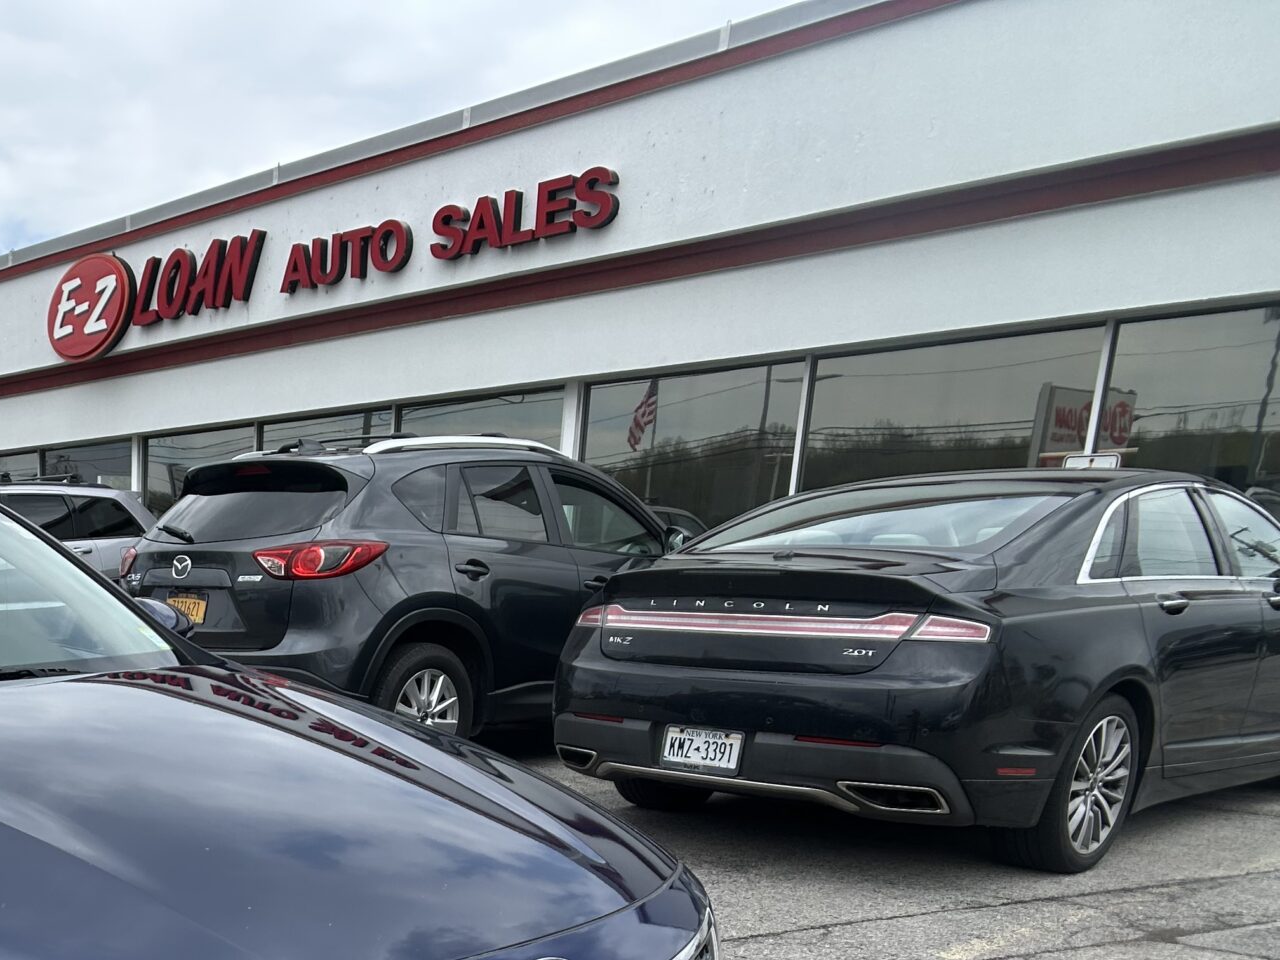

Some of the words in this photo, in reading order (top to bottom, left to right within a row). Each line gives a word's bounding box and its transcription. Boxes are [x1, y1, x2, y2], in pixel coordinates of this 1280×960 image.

[53, 274, 117, 340] E-Z
[132, 229, 267, 326] LOAN
[280, 219, 413, 293] AUTO
[430, 166, 619, 261] SALES
[650, 600, 830, 611] LINCOLN
[685, 729, 702, 737] NEW
[704, 731, 725, 740] YORK
